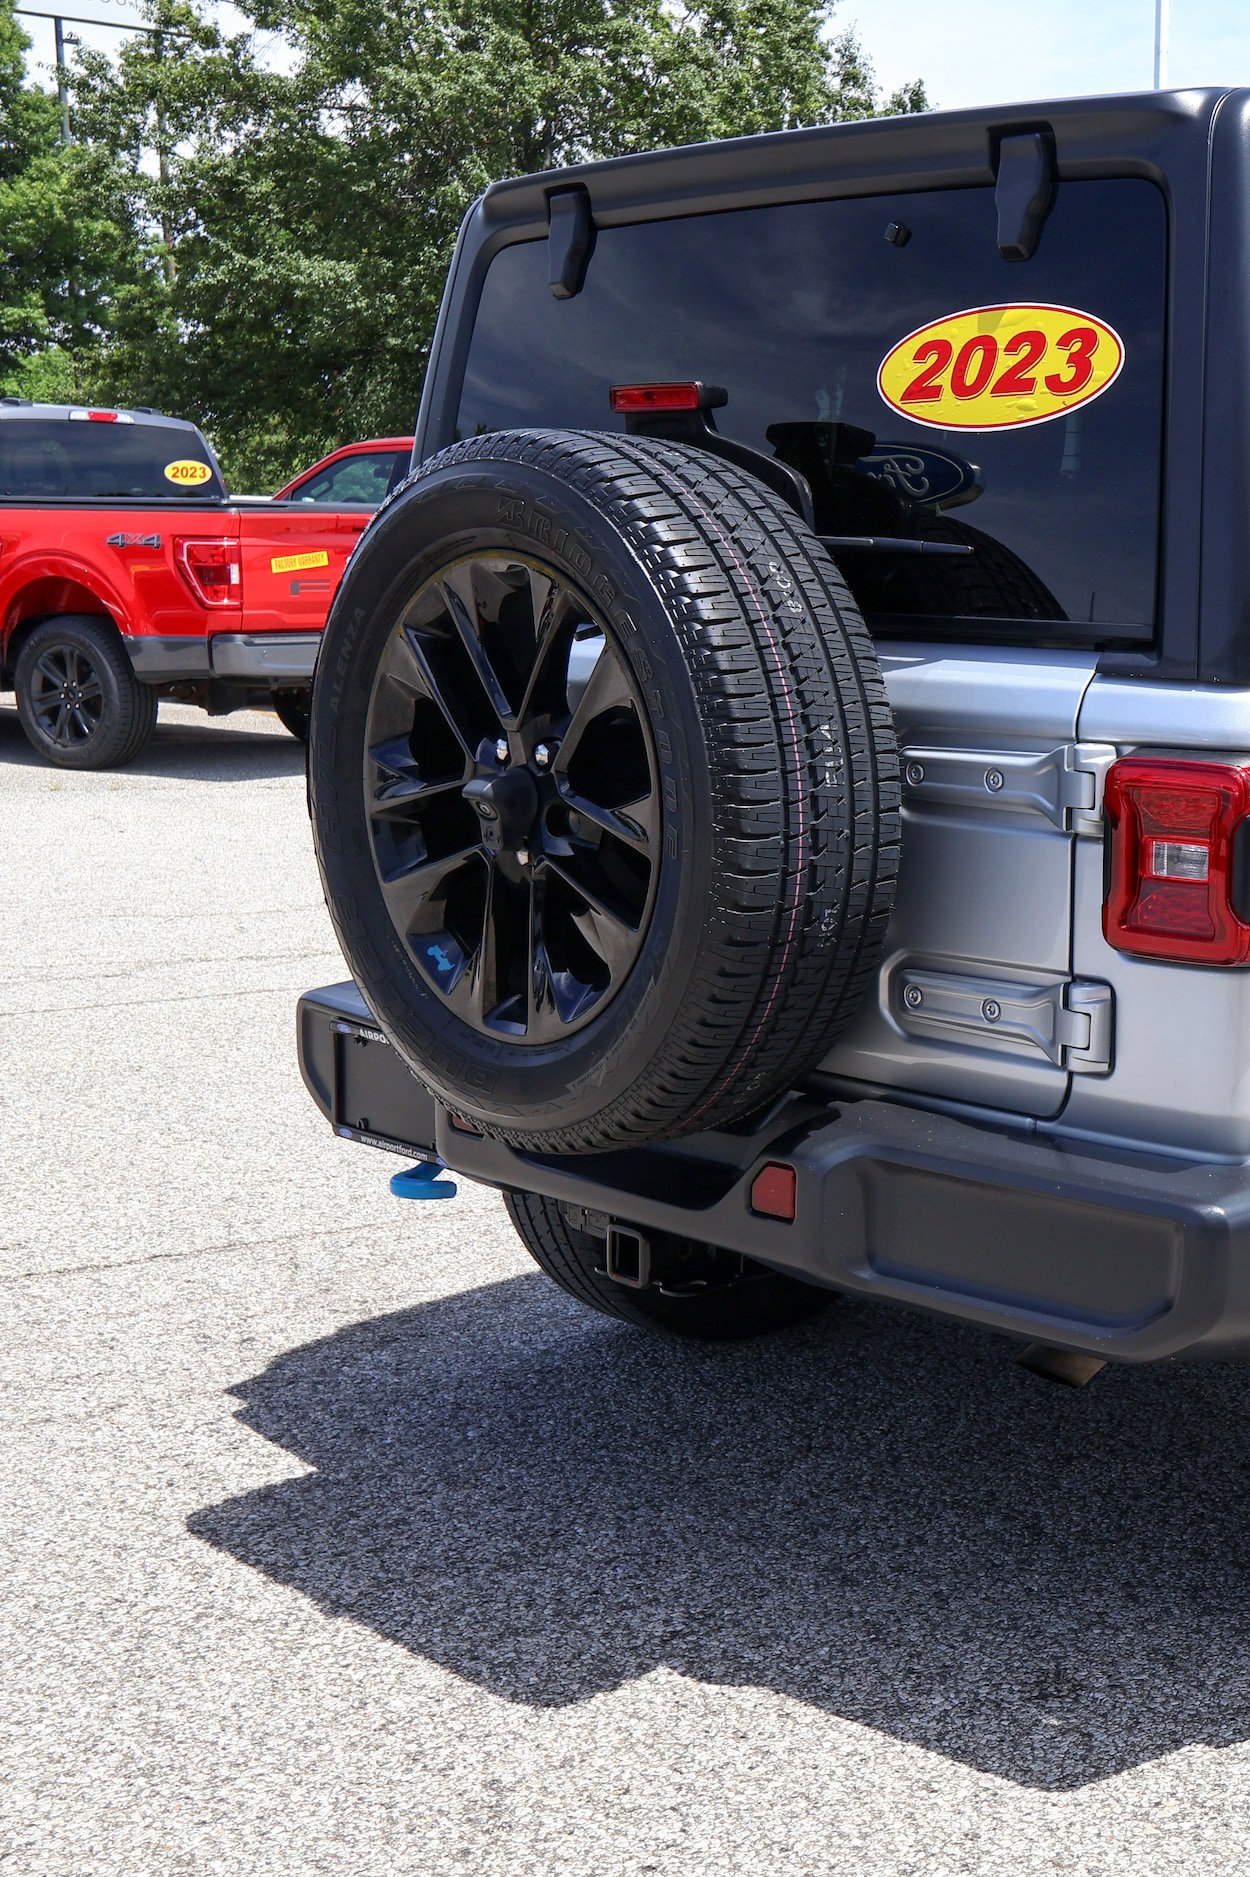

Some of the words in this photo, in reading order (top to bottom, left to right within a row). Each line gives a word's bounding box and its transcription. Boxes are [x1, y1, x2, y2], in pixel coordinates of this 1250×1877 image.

[899, 327, 1100, 404] 2023
[171, 466, 208, 480] 2023
[274, 557, 298, 571] FACTORY
[297, 552, 326, 567] WARRANTY
[330, 606, 367, 713] ALENZA
[495, 495, 679, 861] BRIDGESTONE
[337, 890, 503, 1095] DUELER
[359, 1028, 391, 1045] AIRPO
[360, 1134, 429, 1162] www.airportford.com
